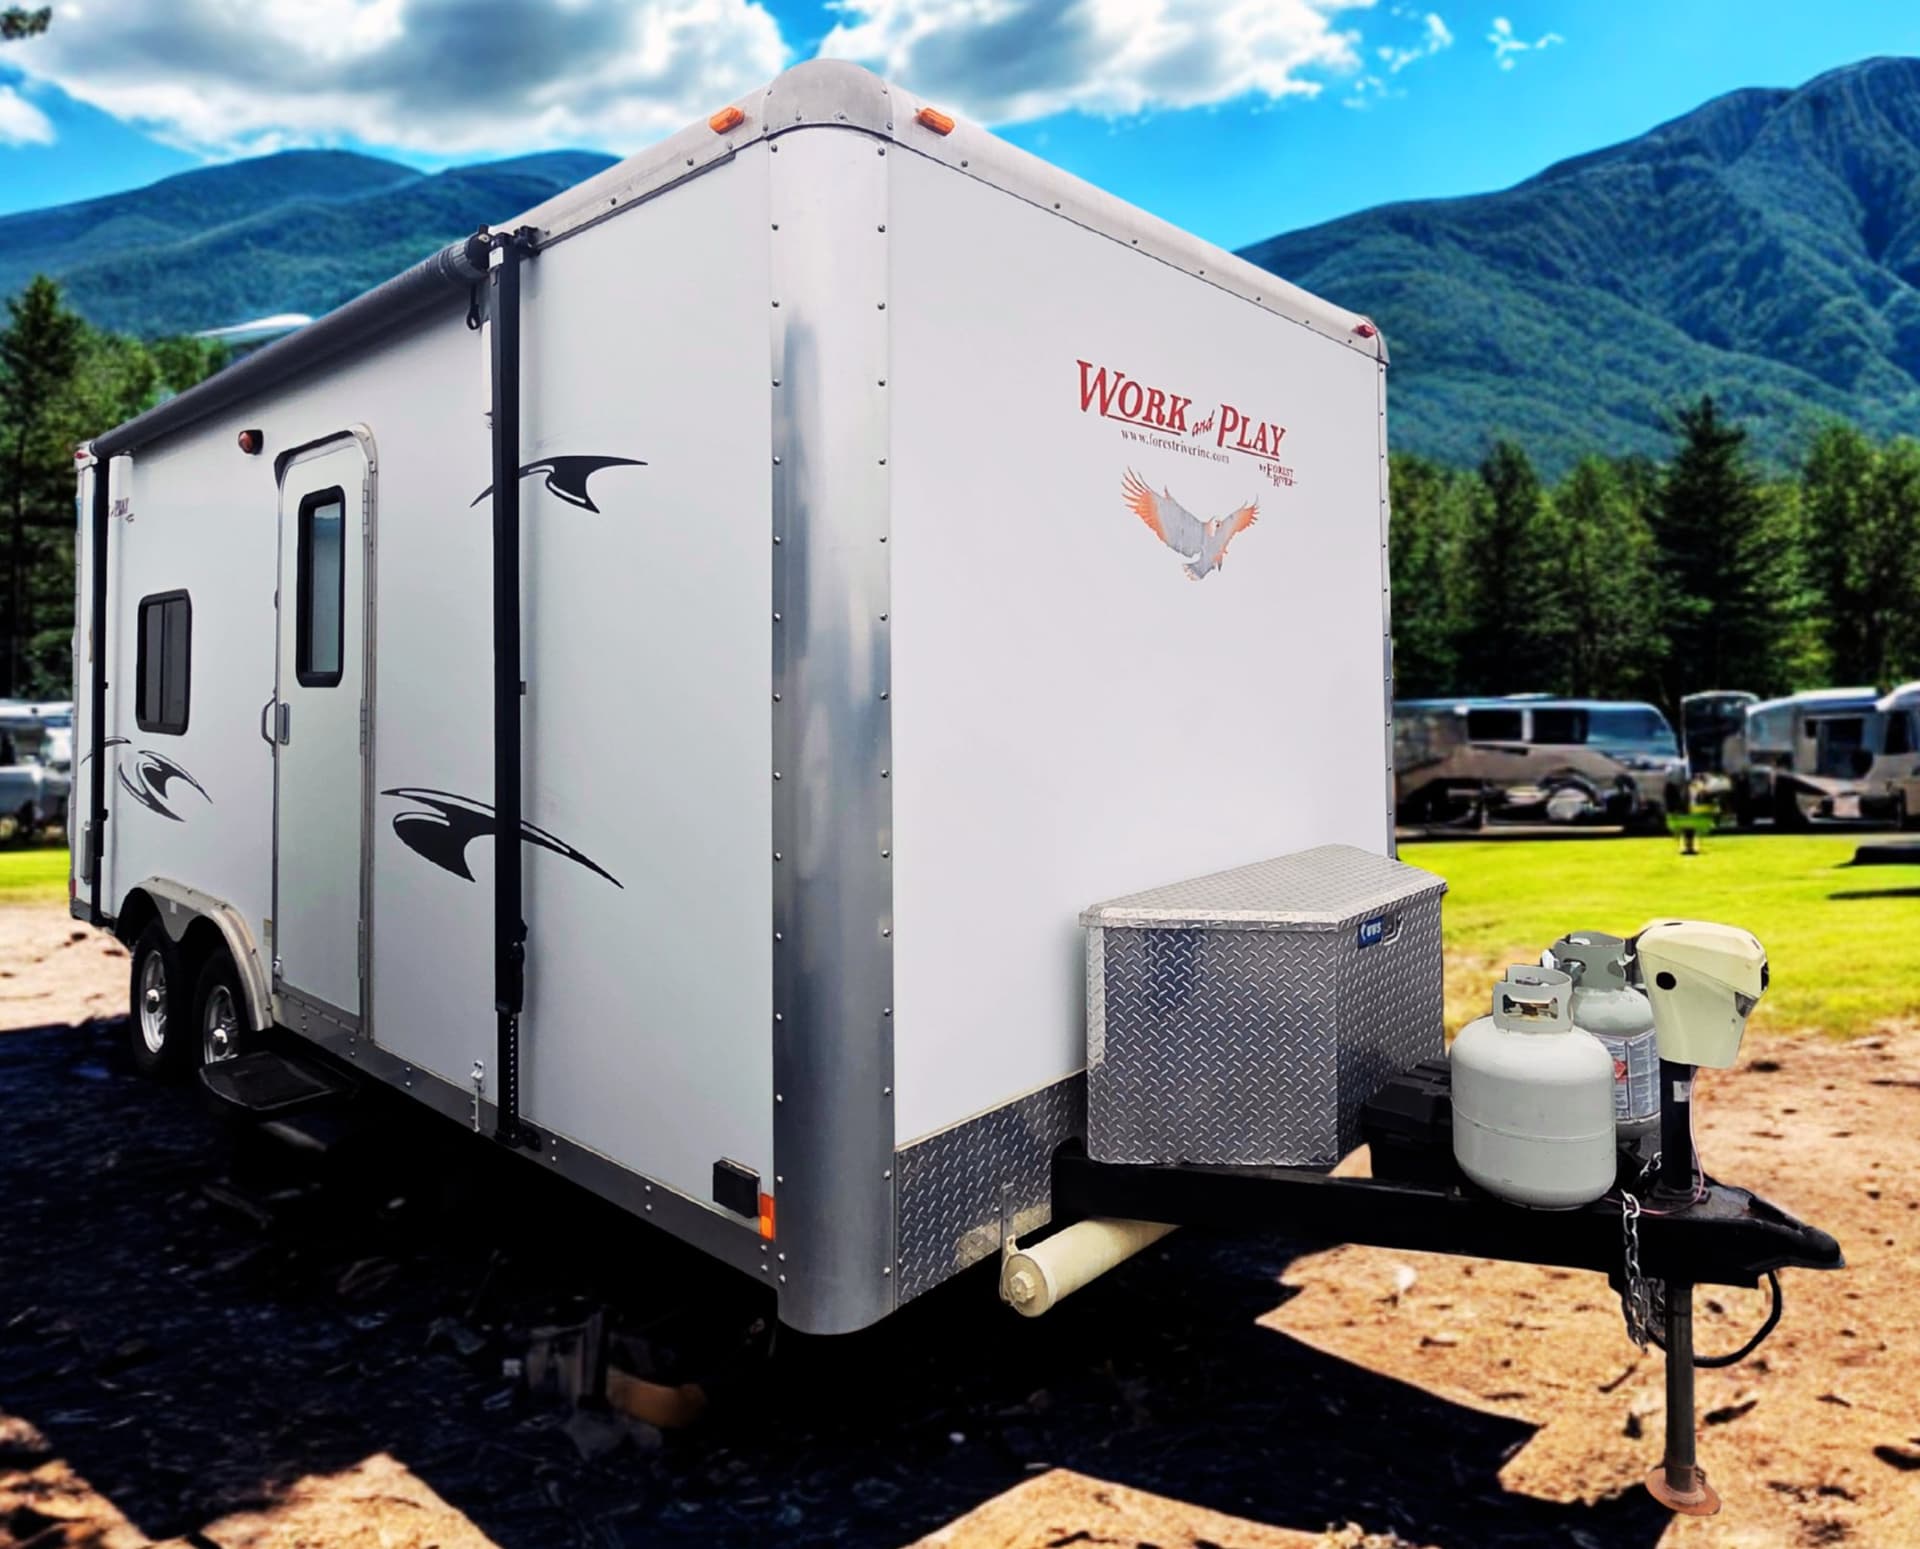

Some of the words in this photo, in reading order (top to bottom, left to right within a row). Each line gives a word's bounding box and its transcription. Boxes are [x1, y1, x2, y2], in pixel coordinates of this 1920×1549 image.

[1076, 359, 1193, 433] WORK
[1192, 409, 1215, 437] and
[1217, 403, 1287, 457] PLAY
[1121, 429, 1230, 464] www.forestriverinc.com
